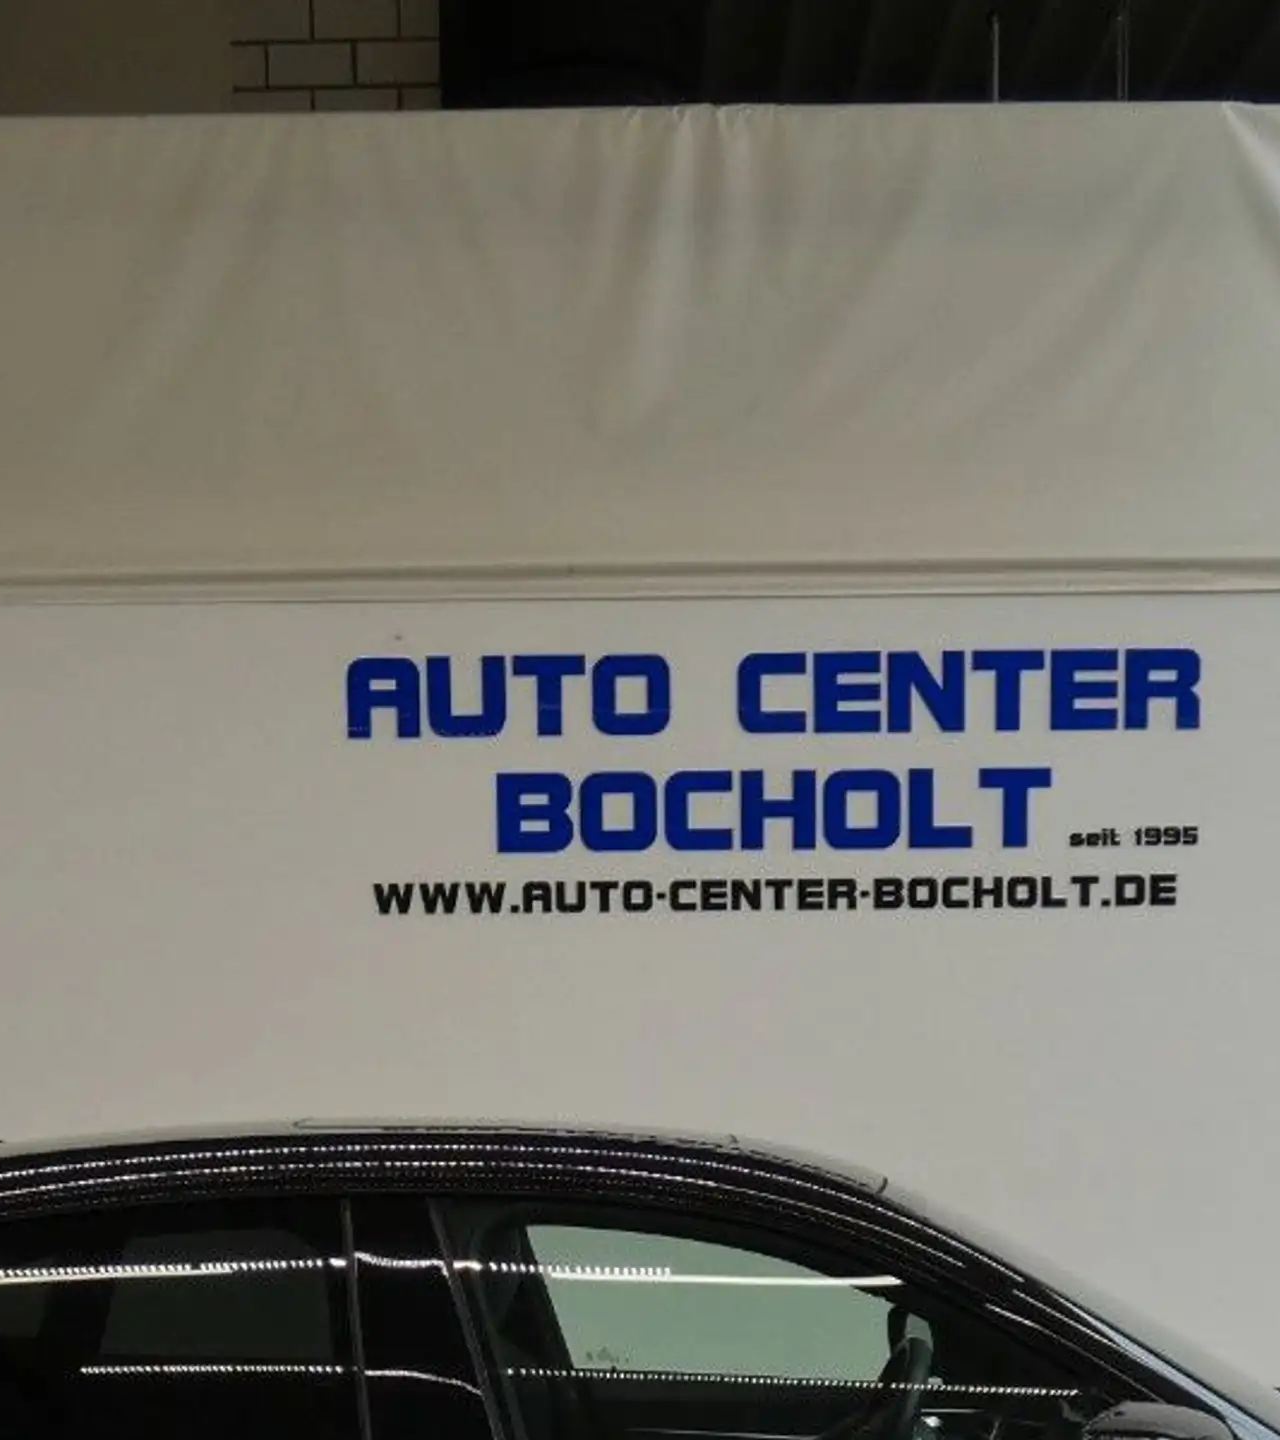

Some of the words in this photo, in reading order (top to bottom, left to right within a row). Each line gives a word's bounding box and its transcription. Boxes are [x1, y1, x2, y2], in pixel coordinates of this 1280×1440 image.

[345, 652, 673, 741] AUTO
[736, 646, 1204, 737] CENTER
[494, 766, 1054, 855] BOCHOLT
[1068, 827, 1122, 848] seit
[1133, 826, 1200, 848] 1995
[372, 873, 1178, 915] WWW.AUTO-CENTER-BOCHOLT.DE
